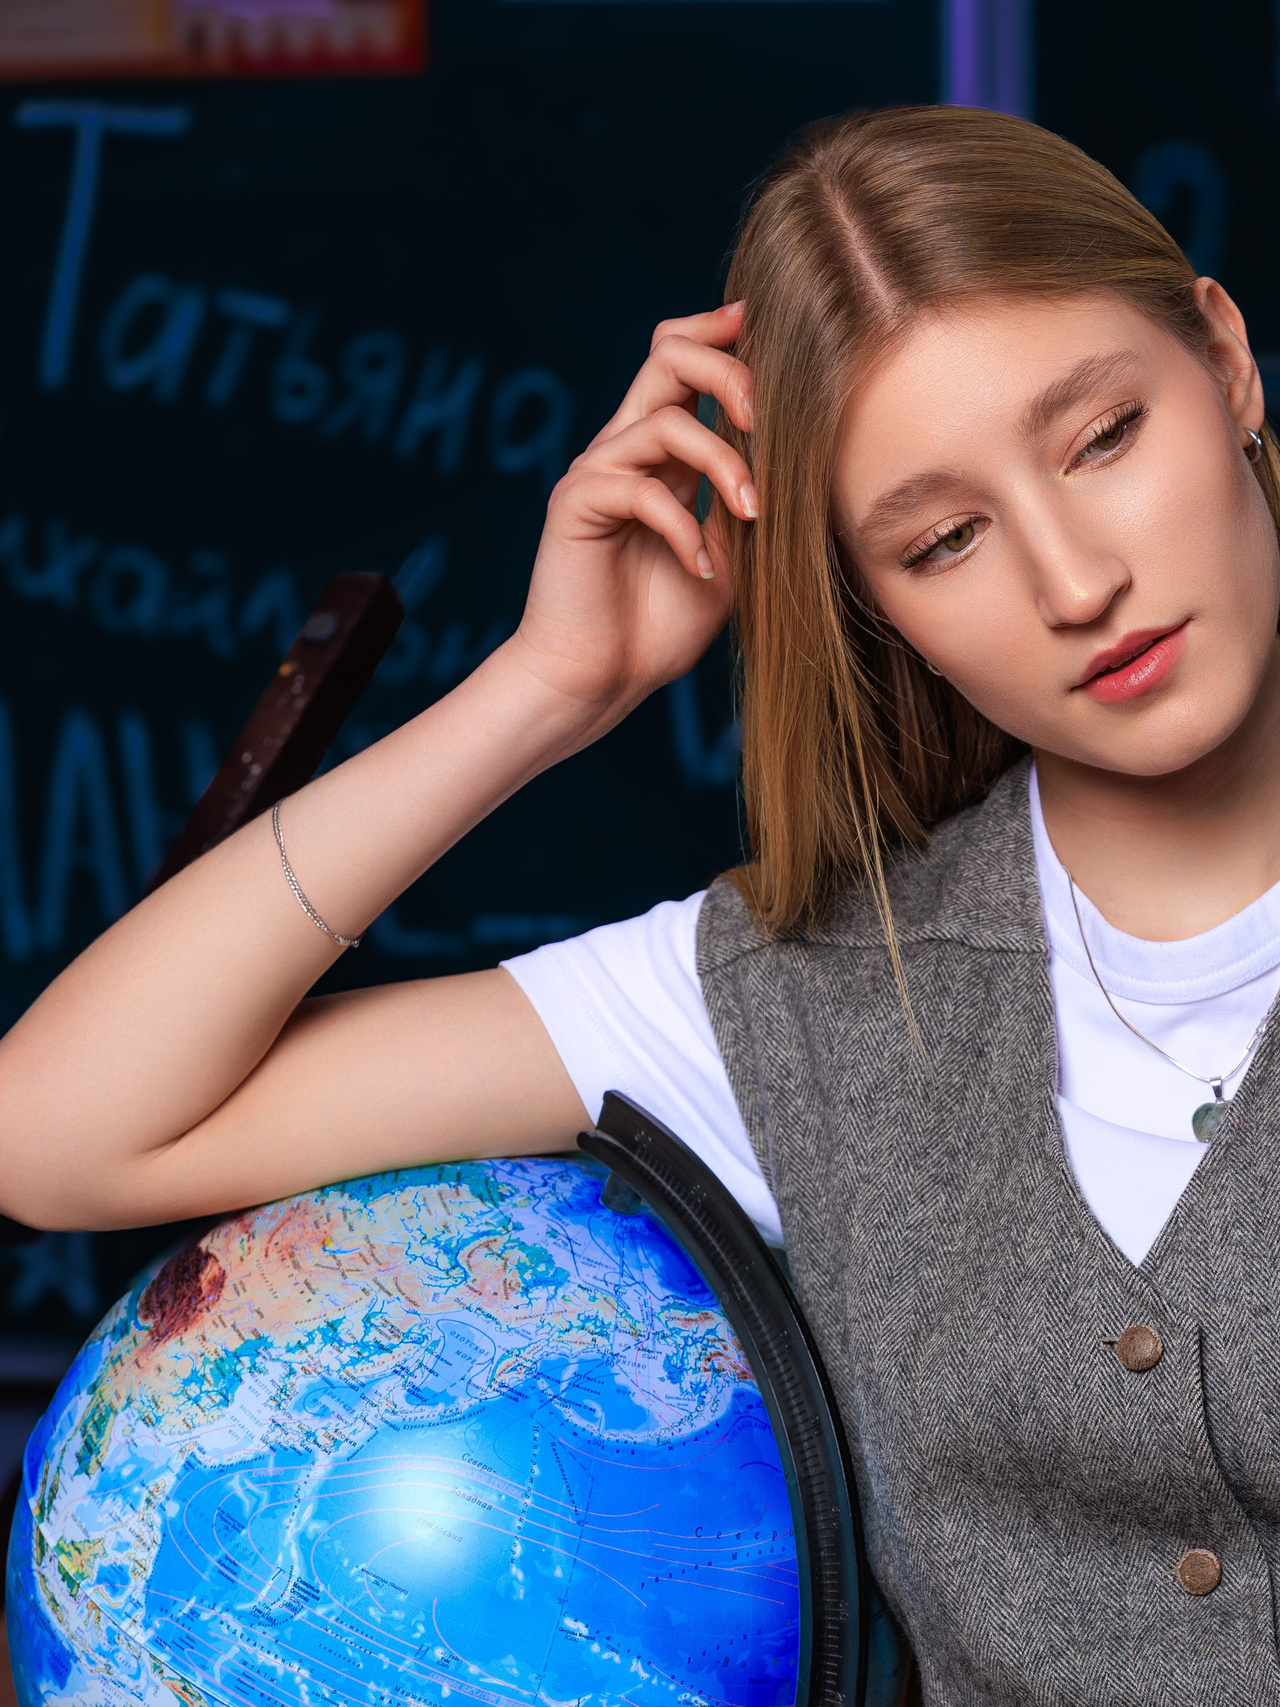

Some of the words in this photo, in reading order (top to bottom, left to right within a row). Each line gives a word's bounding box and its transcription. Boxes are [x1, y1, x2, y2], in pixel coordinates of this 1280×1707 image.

[12, 100, 576, 487] Татьяна
[450, 1330, 491, 1357] ОХОТСКОЕ
[455, 1349, 476, 1364] МОРЕ
[616, 1388, 637, 1398] МОРЕ
[332, 1427, 357, 1448] ЯПОНИЯ
[461, 1452, 497, 1474] Северо-
[550, 1442, 573, 1498] Императорский
[450, 1486, 493, 1512] Западная
[416, 1517, 463, 1543] котловина
[289, 1586, 310, 1604] Острова
[291, 1580, 320, 1603] Марианские
[295, 1575, 320, 1595] Северные
[220, 1620, 301, 1673] ФЕДЕРАТИВНЫЕ
